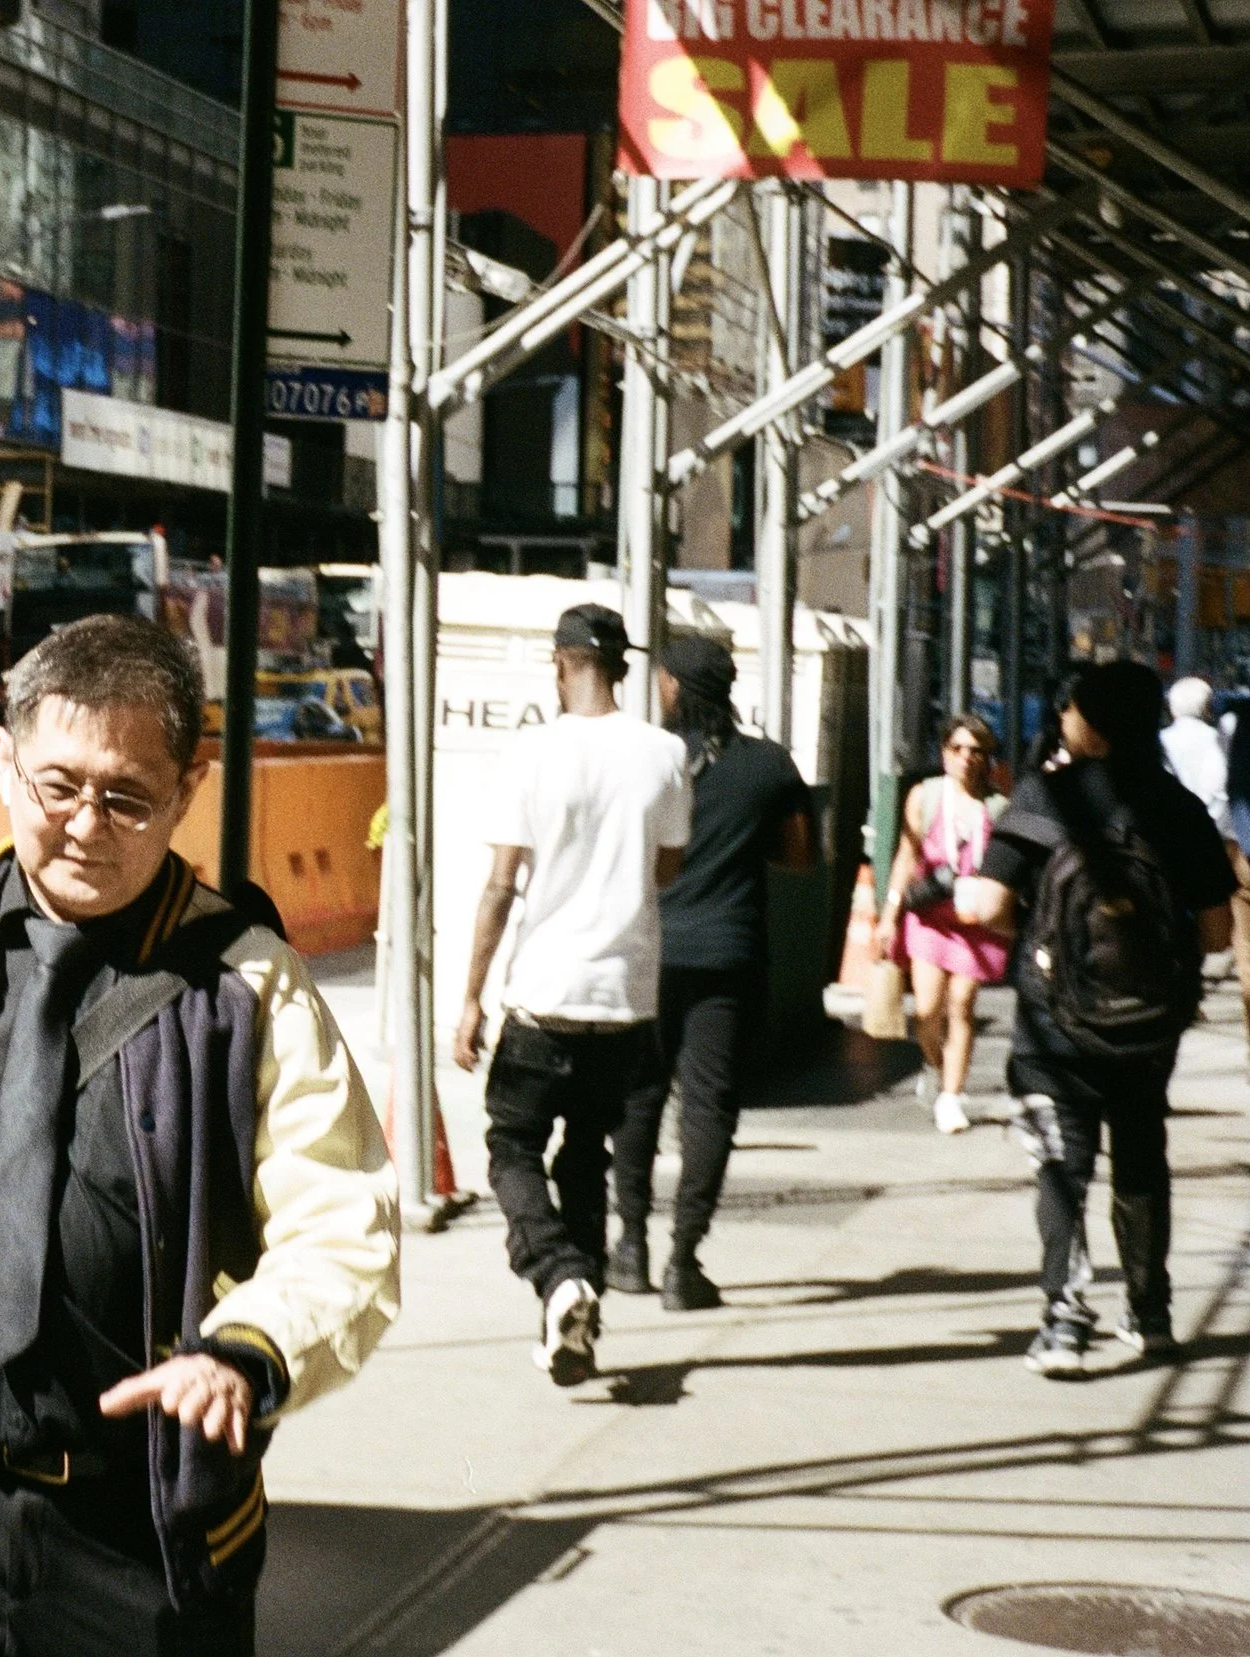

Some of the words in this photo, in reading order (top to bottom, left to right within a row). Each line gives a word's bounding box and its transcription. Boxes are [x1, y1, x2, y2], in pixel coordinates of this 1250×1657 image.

[646, 0, 734, 41] BIG
[748, 0, 1029, 47] CLEARANCE
[647, 56, 1018, 167] SALE
[442, 698, 563, 731] HEA
